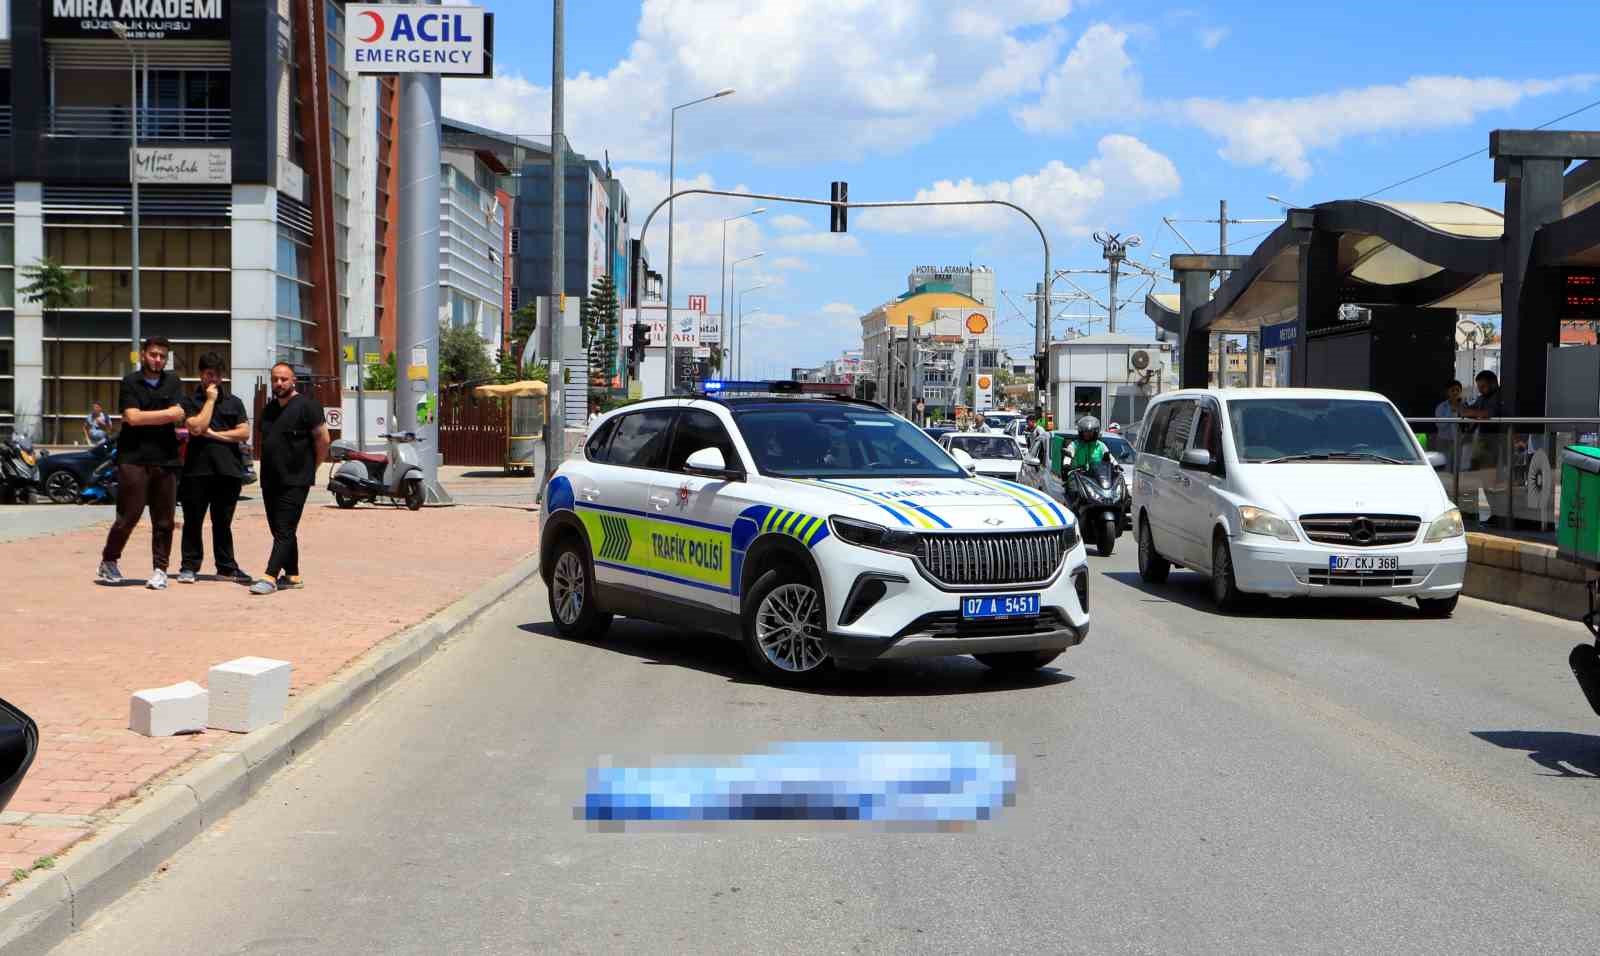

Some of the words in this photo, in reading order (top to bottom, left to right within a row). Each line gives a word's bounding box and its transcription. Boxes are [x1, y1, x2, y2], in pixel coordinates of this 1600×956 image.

[146, 21, 191, 30] KURSU
[355, 48, 473, 64] EMERGENCY
[652, 532, 687, 563] TRAFİK
[689, 538, 722, 571] POLİSİ
[1337, 558, 1349, 569] 07
[1355, 558, 1374, 569] CKJ
[1378, 558, 1396, 569] 368
[968, 599, 982, 614] 07
[990, 599, 997, 613] A
[1006, 597, 1033, 613] 5451
